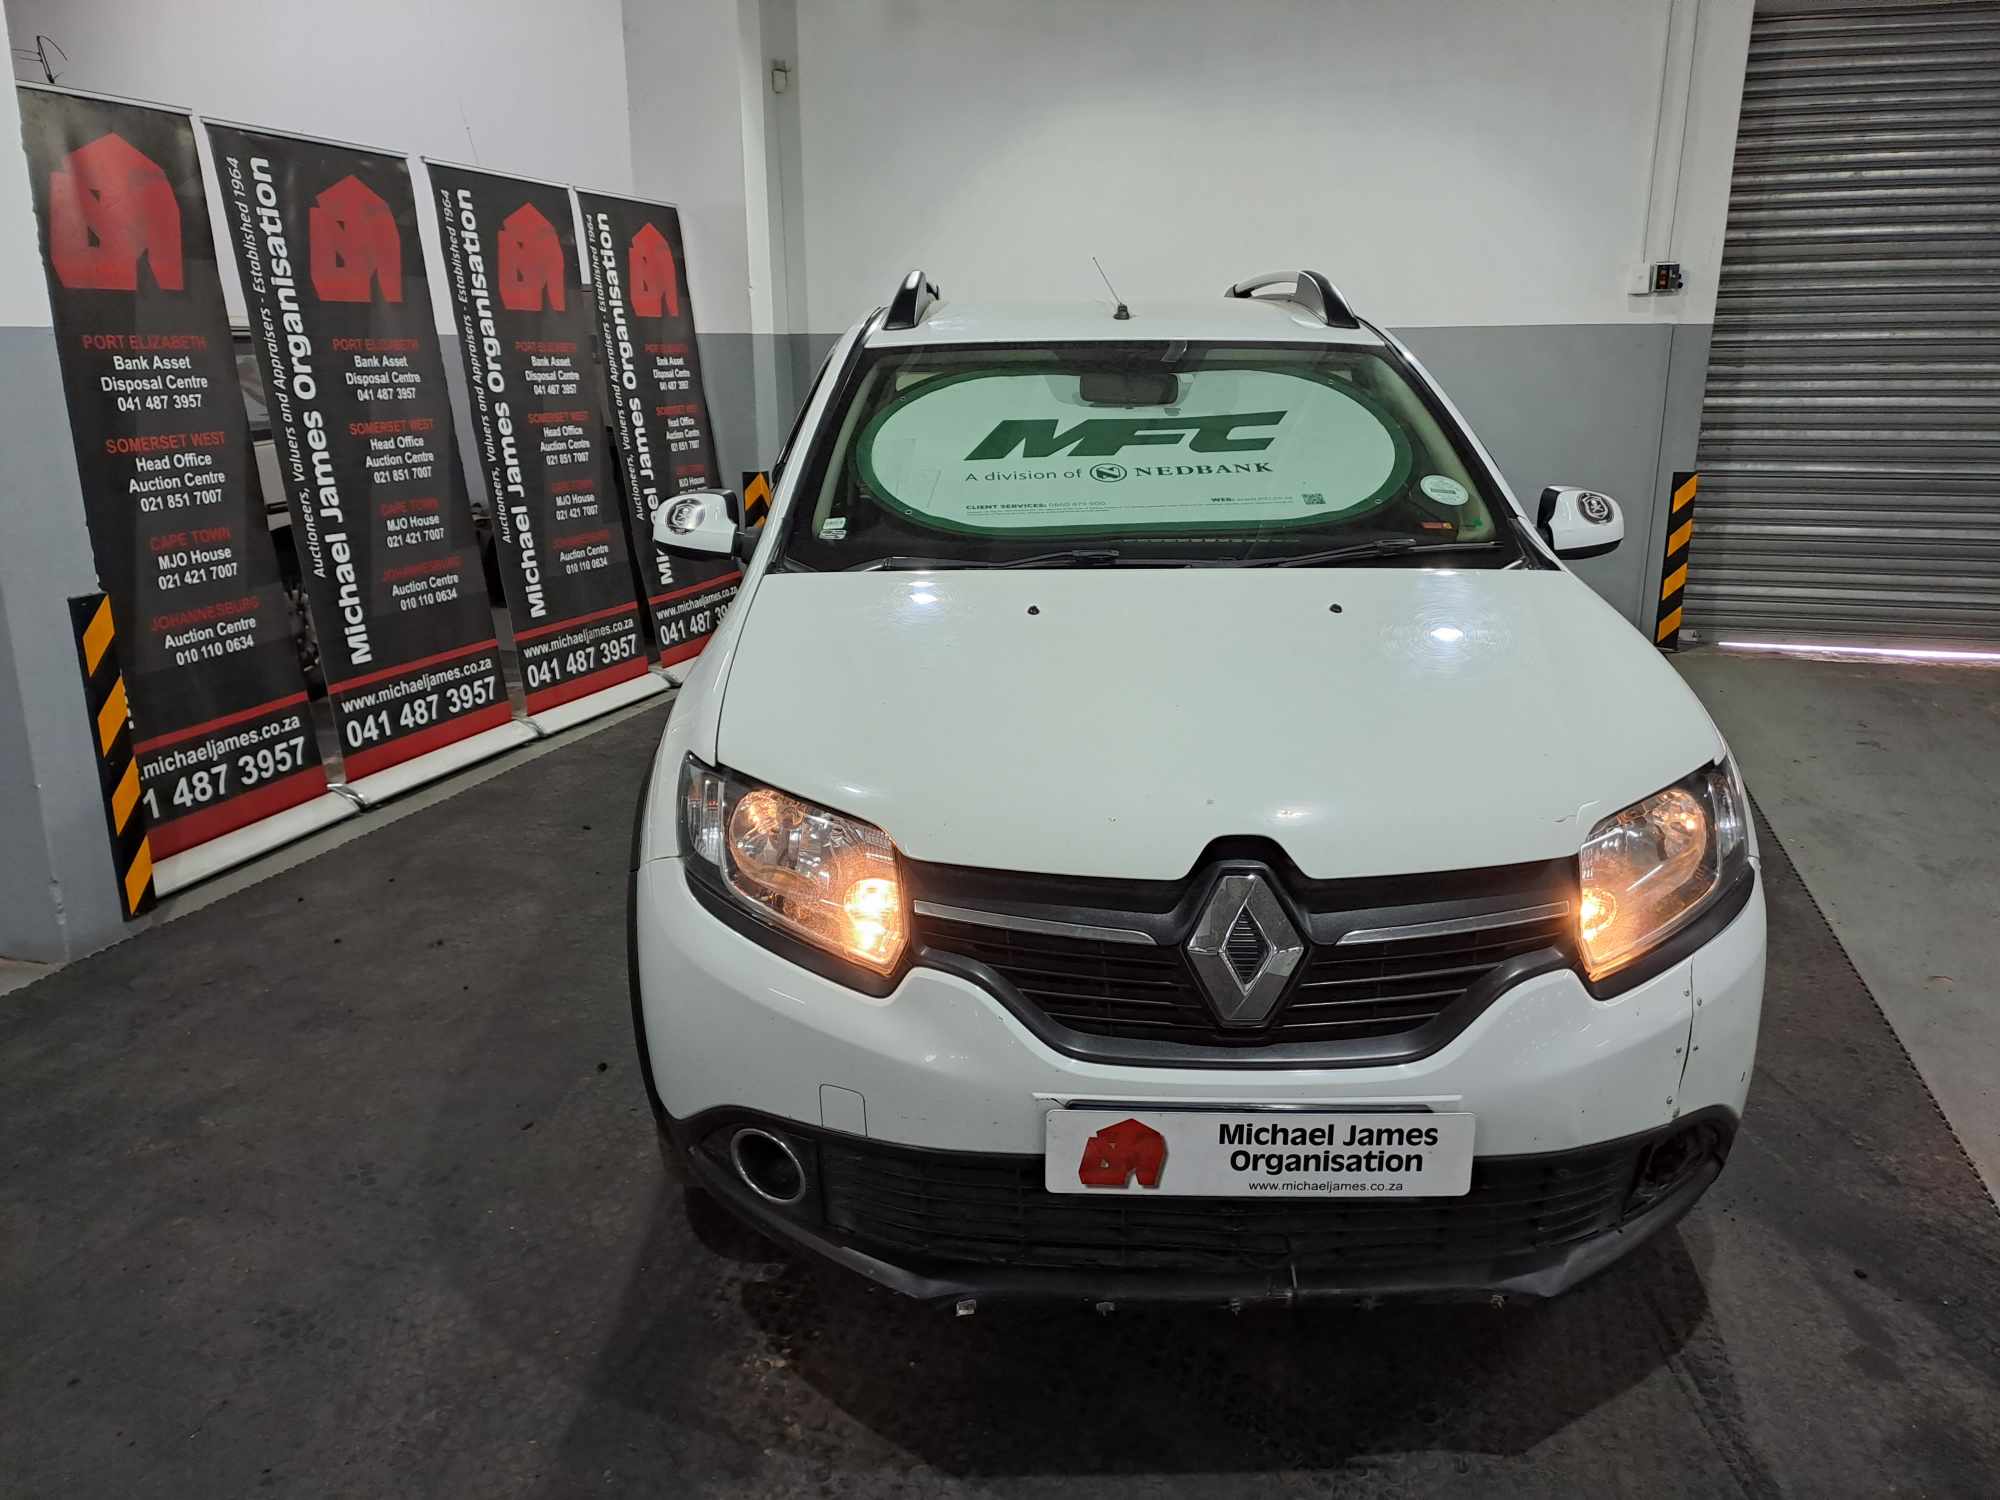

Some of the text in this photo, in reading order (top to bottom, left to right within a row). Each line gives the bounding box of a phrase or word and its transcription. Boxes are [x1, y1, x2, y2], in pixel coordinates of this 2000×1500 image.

[591, 244, 607, 312] Established
[81, 336, 124, 350] PORT
[603, 322, 619, 382] Appraisers
[113, 355, 192, 370] Bank Asset
[226, 156, 328, 578] Auctioneers, Valuers and Appraisers Established 1964
[354, 355, 408, 368] Bank Asset
[440, 189, 512, 544] Auctioneers, Valuers and Appraisers Established 1964
[100, 374, 208, 392] Disposal Centre
[346, 371, 421, 387] Disposal Centre
[117, 394, 202, 412] 041 487 3957
[357, 387, 416, 402] 041 487 3957
[456, 188, 547, 618] Michael James Organisation
[596, 212, 674, 585] Miel James Organisation
[611, 384, 624, 407] and
[250, 156, 373, 666] Michael James Organisation
[617, 410, 631, 450] Valuers
[964, 410, 1288, 461] MFC
[105, 432, 225, 453] SOMERSET WEST
[370, 435, 424, 451] Head Office
[136, 453, 212, 472] Head Office
[366, 452, 434, 468] Auction Centre
[1135, 462, 1273, 477] NEDBANK
[129, 471, 226, 494] Auction Centre
[374, 466, 432, 484] 021 851 7007
[966, 469, 1083, 482] A division of
[140, 489, 222, 512] 021 851 7007
[386, 514, 440, 532] MJO House
[150, 527, 232, 549] CAPE TOWN
[386, 528, 445, 548] 021 421 7007
[158, 548, 232, 570] MJO House
[560, 551, 586, 562] Auction
[158, 562, 238, 590] 021 421 7007
[392, 574, 460, 597] Auction Centre
[400, 588, 458, 611] 010 110 0634
[164, 616, 256, 649] Auction Centre
[524, 618, 634, 659] www.michaeljames.co.za
[660, 620, 686, 645] 041
[690, 610, 711, 634] 487
[176, 634, 254, 666] 010 110 0634
[527, 634, 637, 688] 041 487 3957
[341, 658, 492, 714] www.michaeljames.co.za
[346, 676, 496, 748] 041 487 3957
[140, 714, 300, 780] .michaeljames.co.za
[172, 763, 228, 808] 487
[238, 736, 304, 785] 3957
[1218, 1124, 1438, 1146] Michael James
[1230, 1150, 1424, 1176] Organisation
[1248, 1180, 1404, 1193] www.michaeljames.co.za
